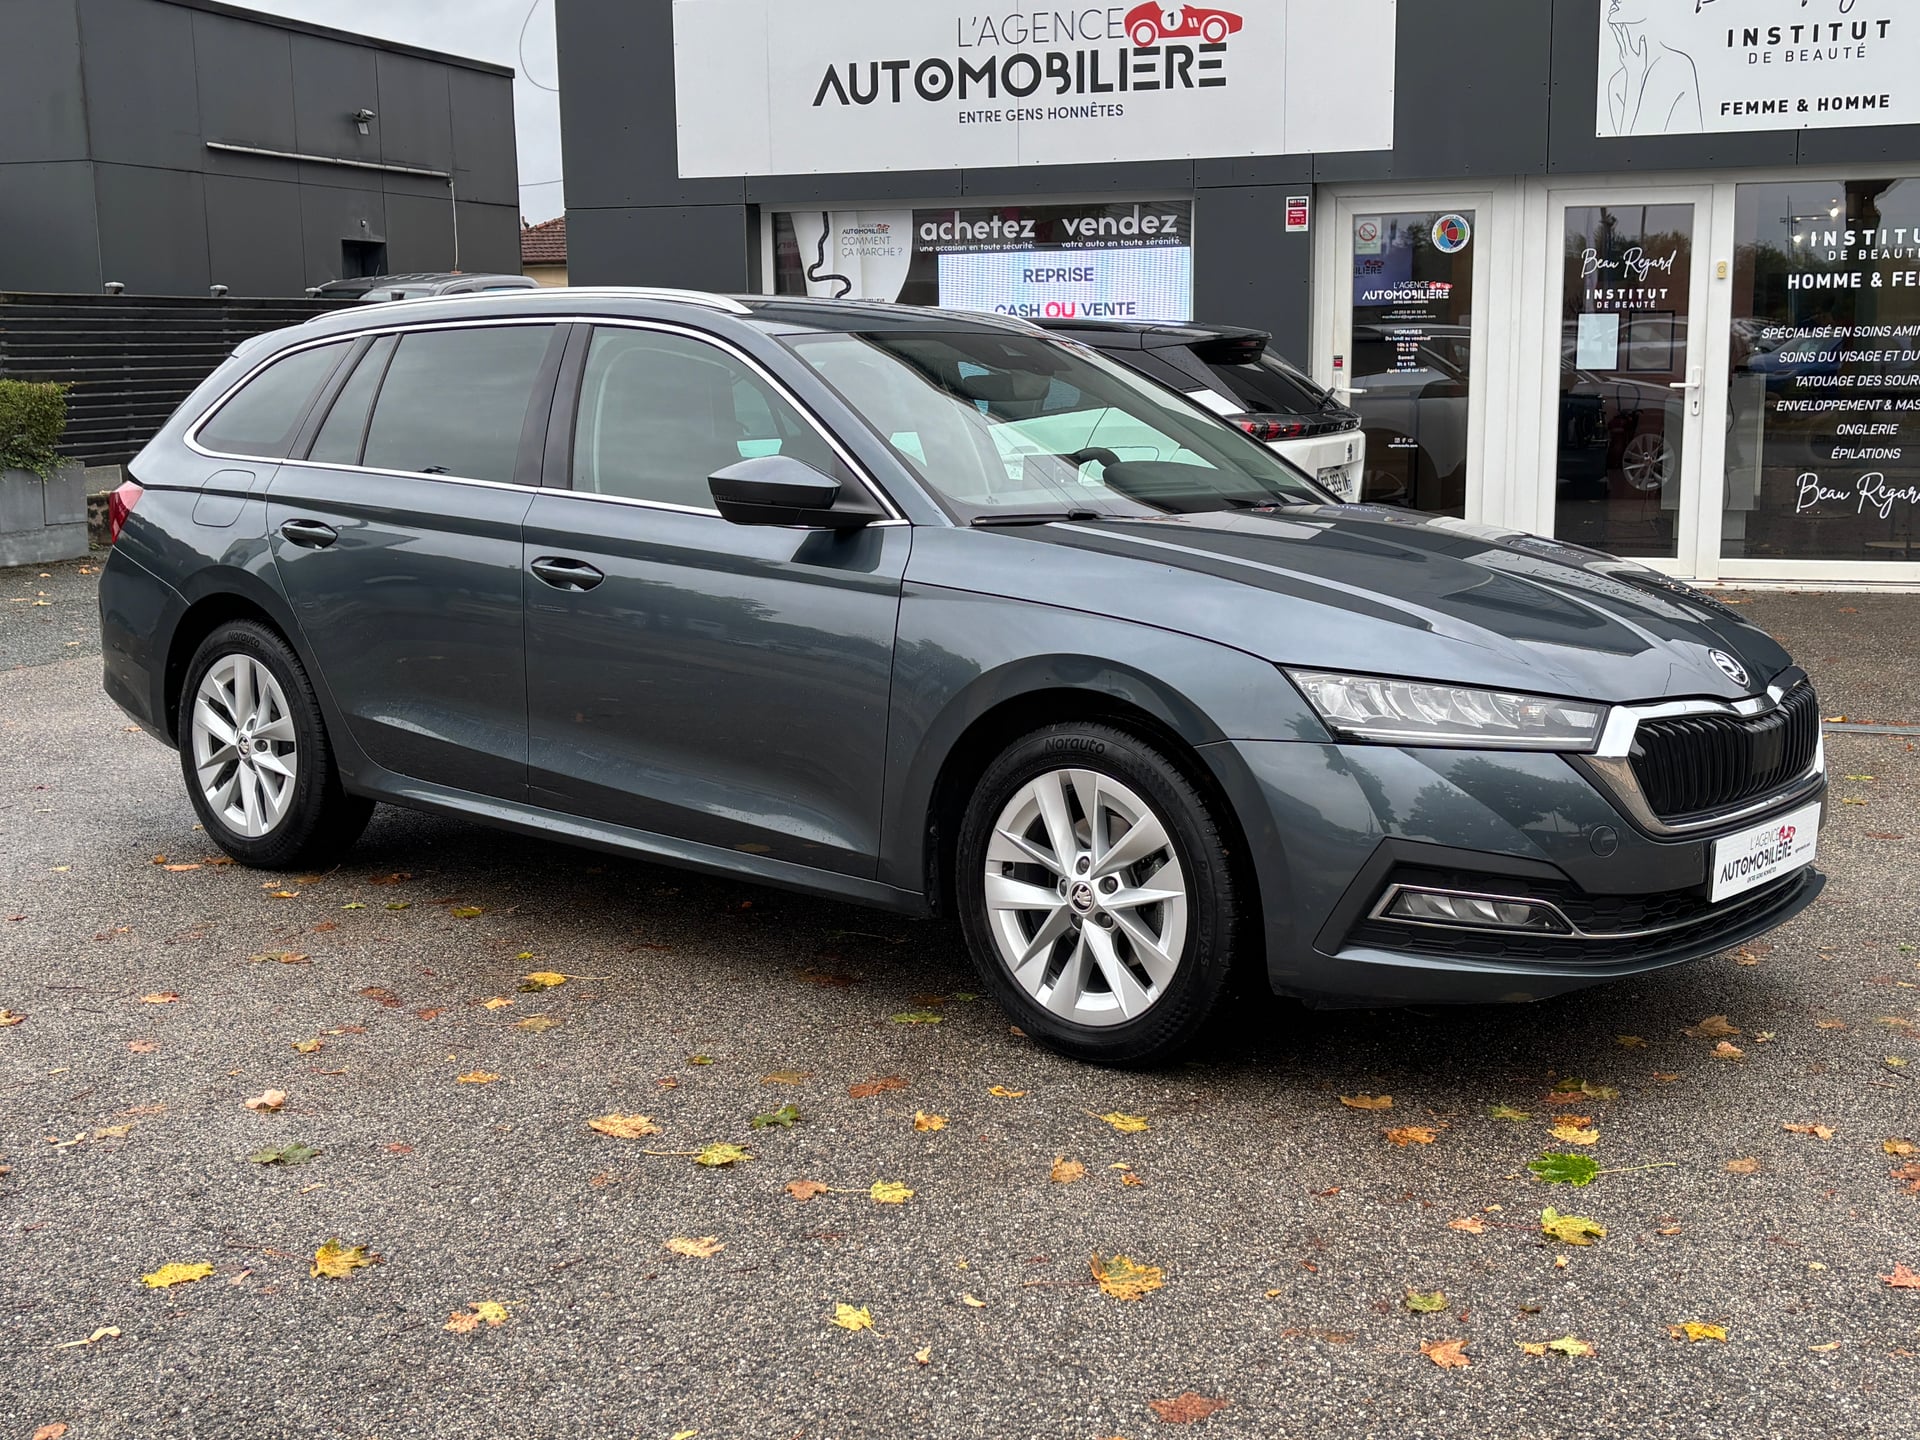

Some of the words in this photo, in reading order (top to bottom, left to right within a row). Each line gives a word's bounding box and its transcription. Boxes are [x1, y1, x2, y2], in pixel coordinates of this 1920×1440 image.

[957, 7, 1124, 49] L'AGENCE
[1727, 19, 1891, 47] INSTITUT
[1748, 50, 1772, 64] DE
[1785, 43, 1866, 62] BEAUTÉ
[958, 109, 1000, 124] ENTRE
[1005, 107, 1044, 122] GENS
[1047, 102, 1124, 119] HONNÊTES
[1720, 100, 1788, 116] FEMME
[1796, 98, 1809, 112] &
[1817, 94, 1890, 111] HOMME
[919, 211, 1035, 241] achetez
[1061, 204, 1178, 237] vendez
[841, 236, 892, 246] COMMENT
[935, 244, 967, 252] occasion
[980, 243, 1001, 251] toute
[1003, 241, 1035, 250] sécurité.
[1085, 240, 1105, 248] auto
[1120, 239, 1143, 247] toute
[1146, 235, 1182, 246] sérénité.
[841, 247, 854, 258] ÇA
[856, 247, 895, 256] MARCHE
[897, 247, 903, 256] ?
[1828, 250, 1848, 261] DE
[1581, 247, 1619, 279] Beau
[1623, 246, 1677, 282] Regard
[1023, 267, 1095, 283] REPRISE
[1787, 272, 1862, 290] HOMME
[1870, 271, 1883, 288] &
[1892, 271, 1920, 287] FE
[1393, 281, 1429, 289] L'AGENCE
[1586, 288, 1668, 299] INSTITUT
[995, 303, 1041, 317] CASH
[1045, 301, 1076, 318] OU
[1082, 302, 1136, 316] VENTE
[1615, 300, 1656, 308] BEAUTÉ
[1761, 323, 1832, 339] SPÉCIALISÉ
[1833, 326, 1851, 338] EN
[1853, 325, 1891, 338] SOINS
[1778, 351, 1815, 363] SOINS
[1818, 351, 1837, 363] DU
[1838, 350, 1882, 362] VISAGE
[1884, 350, 1901, 361] ET
[1795, 375, 1854, 387] TATOUAGE
[1857, 374, 1882, 386] DES
[1884, 374, 1920, 386] SOUR
[1776, 399, 1883, 412] ENVELOPPEMENT
[1884, 399, 1892, 411] &
[1836, 423, 1899, 435] ONGLERIE
[1831, 446, 1902, 459] ÉPILATIONS
[1796, 471, 1851, 514] Beau
[1856, 471, 1920, 519] Regar
[228, 631, 260, 648] Norauto
[1044, 738, 1105, 754] Norauto
